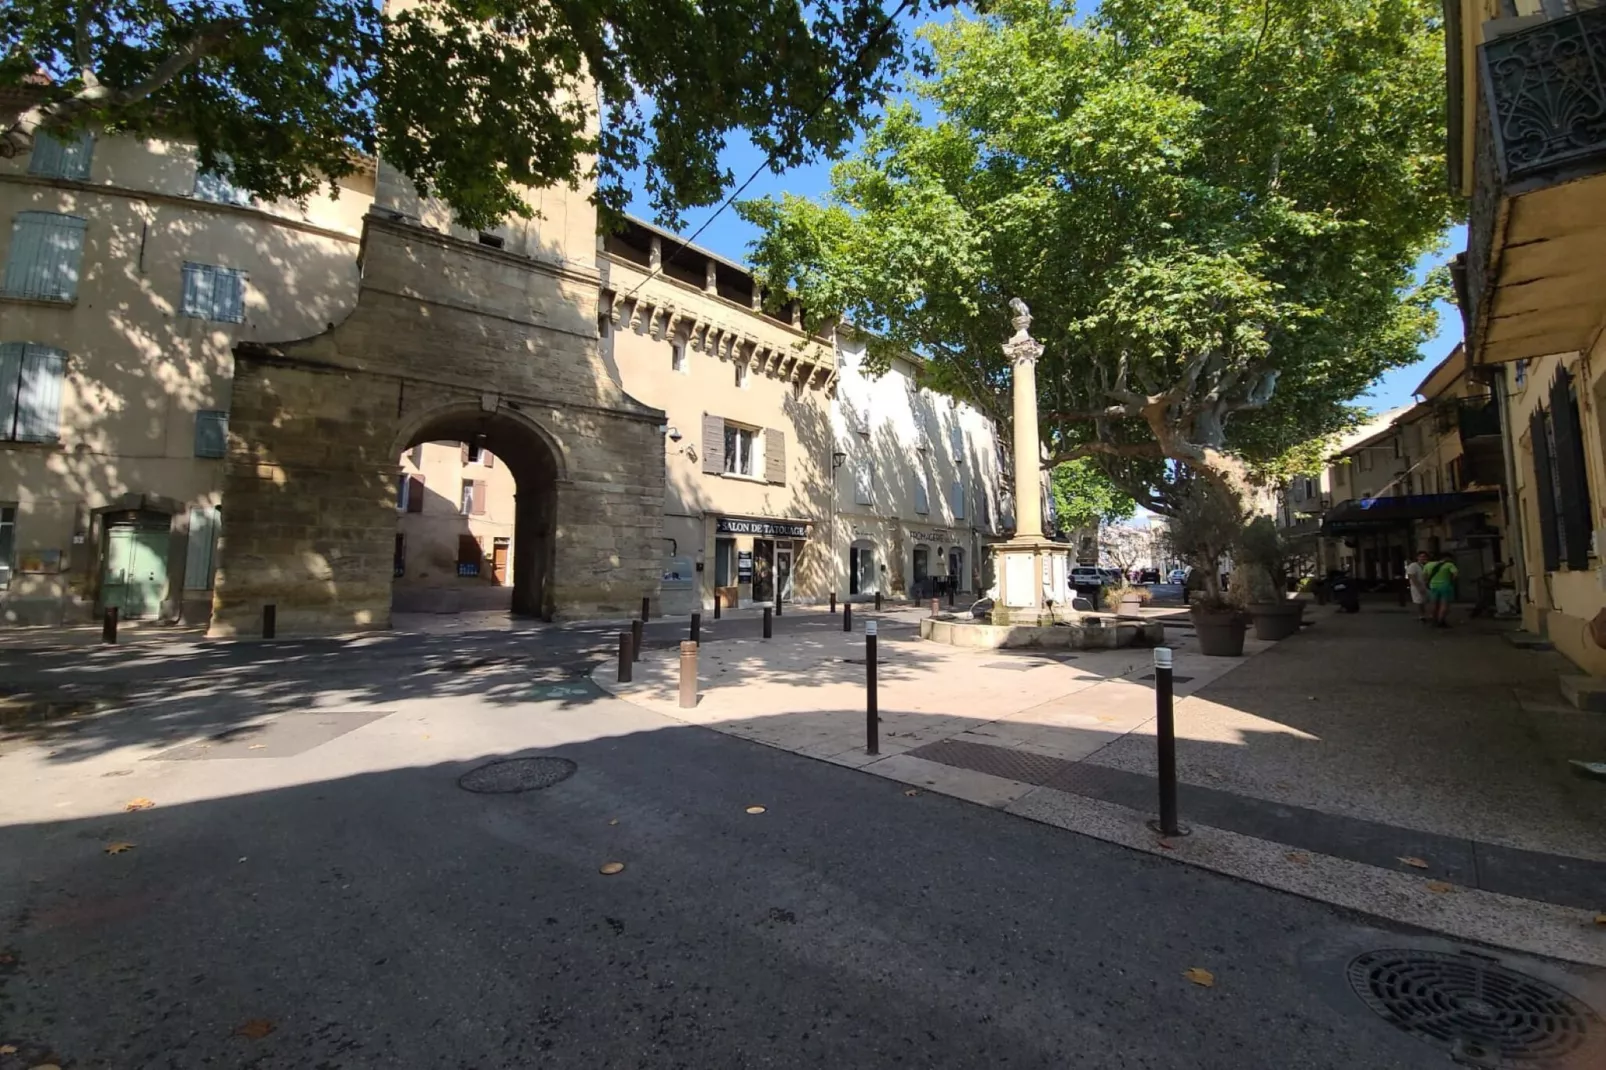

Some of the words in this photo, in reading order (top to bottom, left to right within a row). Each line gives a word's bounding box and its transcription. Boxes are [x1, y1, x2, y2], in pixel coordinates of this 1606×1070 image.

[722, 523, 749, 532] SALON
[752, 524, 763, 533] DE
[763, 524, 804, 536] TATOUAGE
